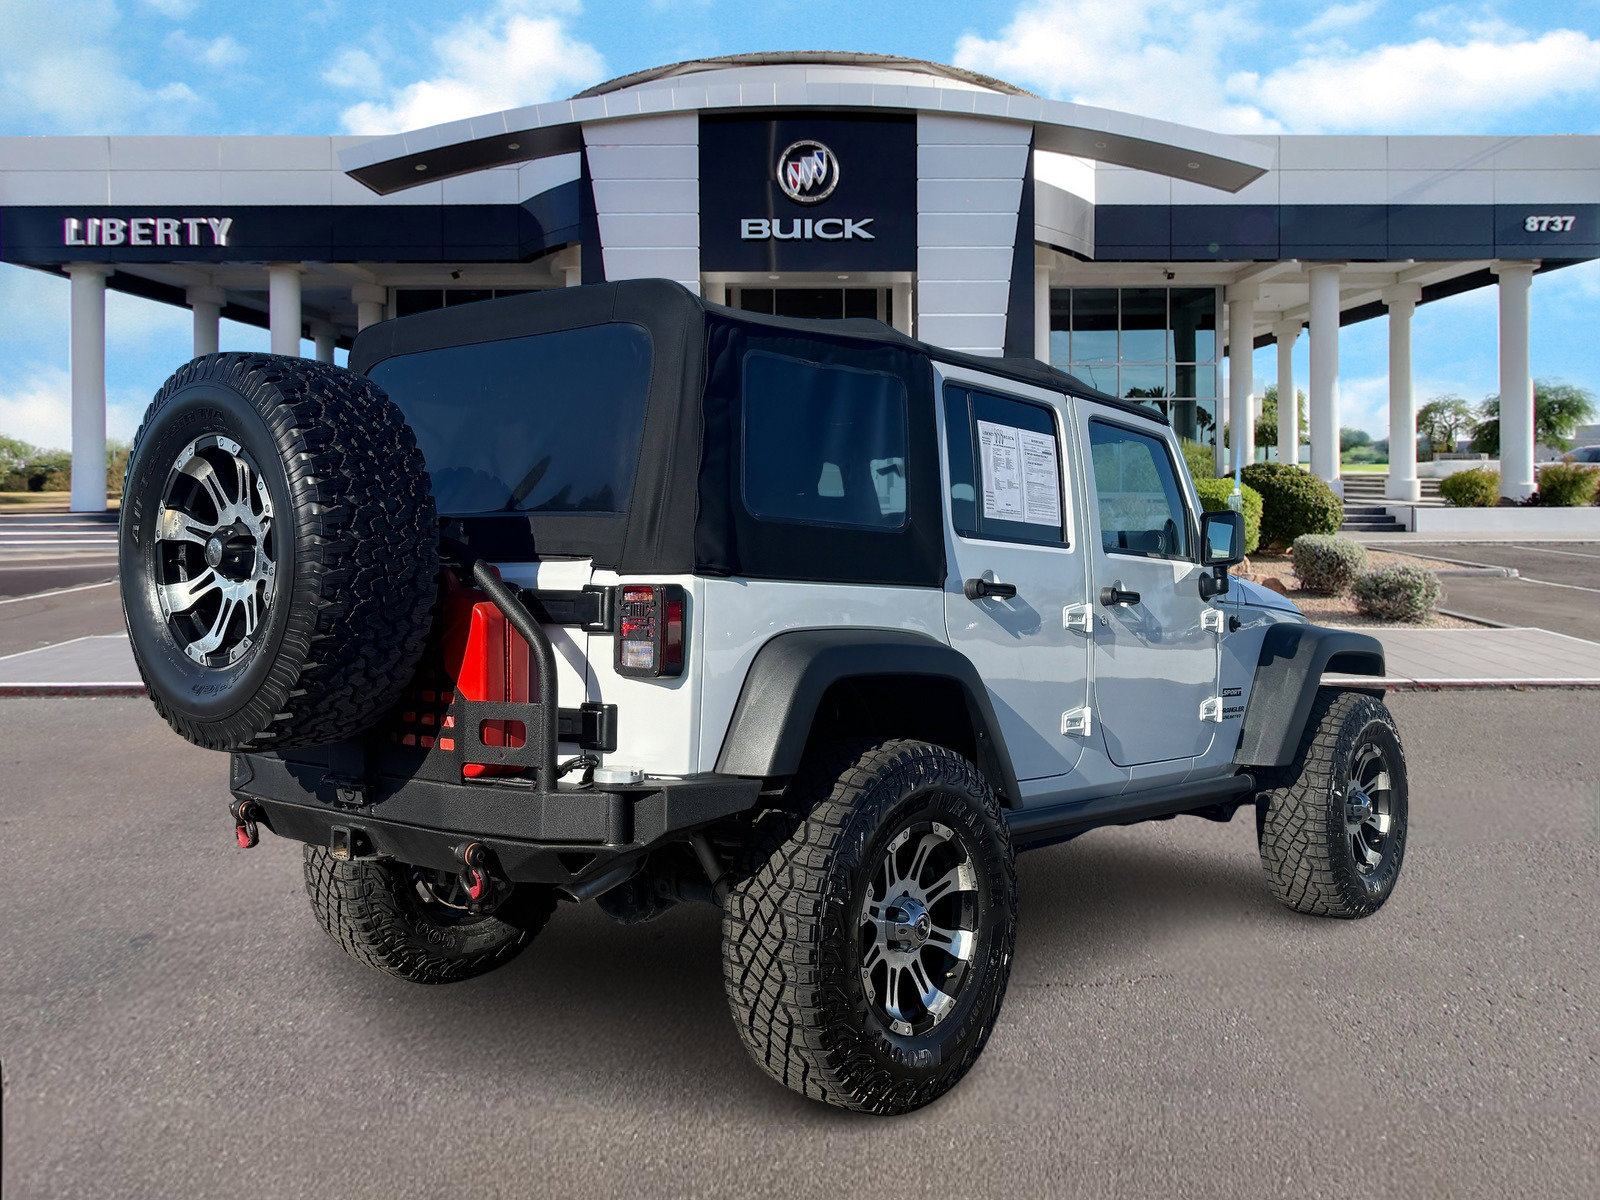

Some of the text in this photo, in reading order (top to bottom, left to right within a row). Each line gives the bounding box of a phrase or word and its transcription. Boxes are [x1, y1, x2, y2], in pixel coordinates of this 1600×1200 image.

[63, 216, 234, 247] LIBERTY
[741, 218, 875, 240] BUICK
[1524, 215, 1576, 232] 8737
[1222, 688, 1241, 696] SPORT
